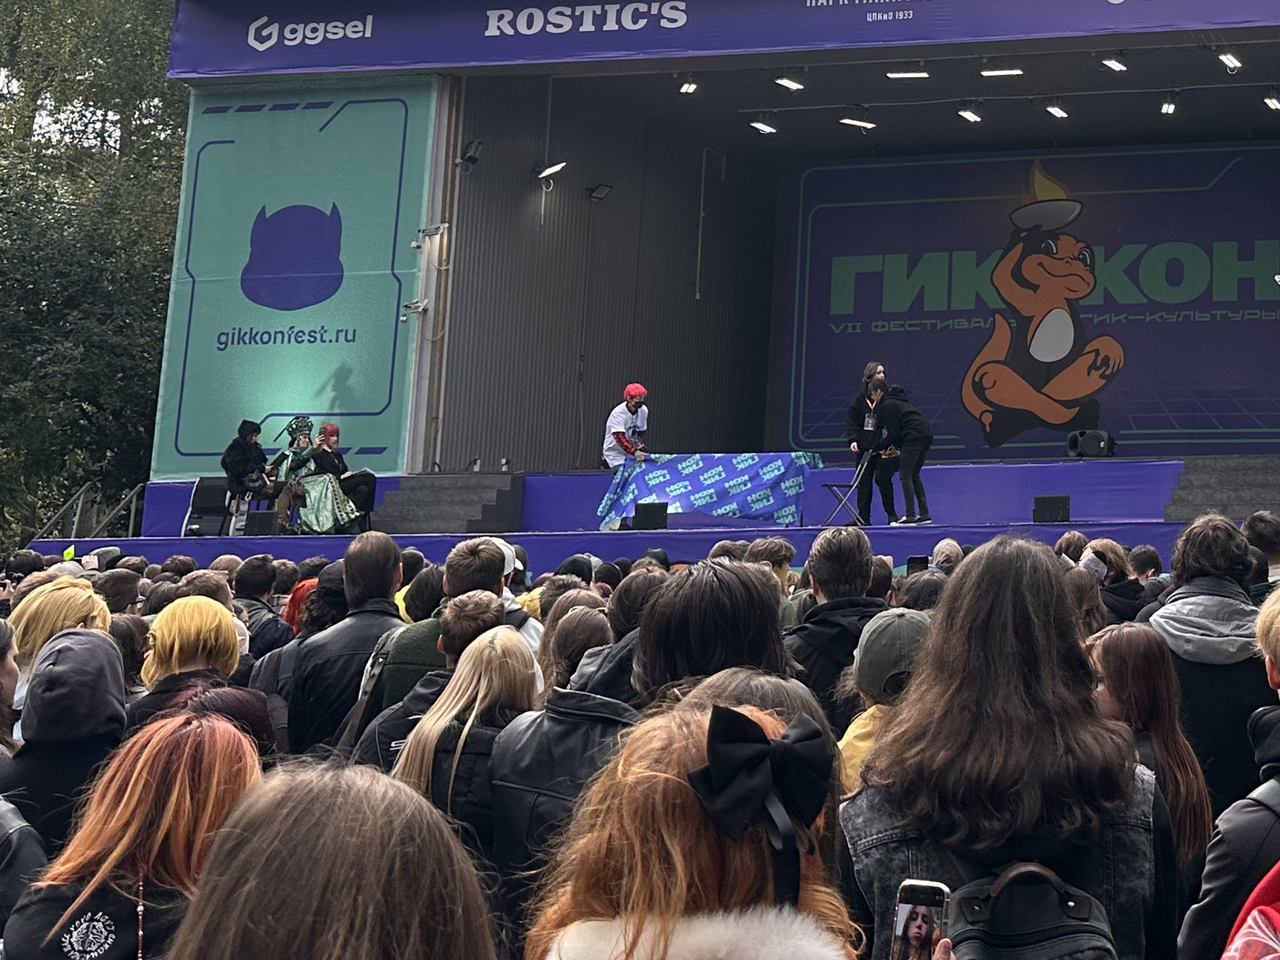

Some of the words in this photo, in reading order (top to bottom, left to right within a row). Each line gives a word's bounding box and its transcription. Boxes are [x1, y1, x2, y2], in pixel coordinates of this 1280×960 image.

[485, 1, 688, 37] ROSTIC'S
[895, 10, 914, 20] 1933
[283, 14, 373, 46] ggsel
[830, 249, 1008, 315] ГИК
[1078, 240, 1280, 305] КОН
[216, 325, 357, 352] gikkonfest.ru
[830, 322, 863, 334] VII
